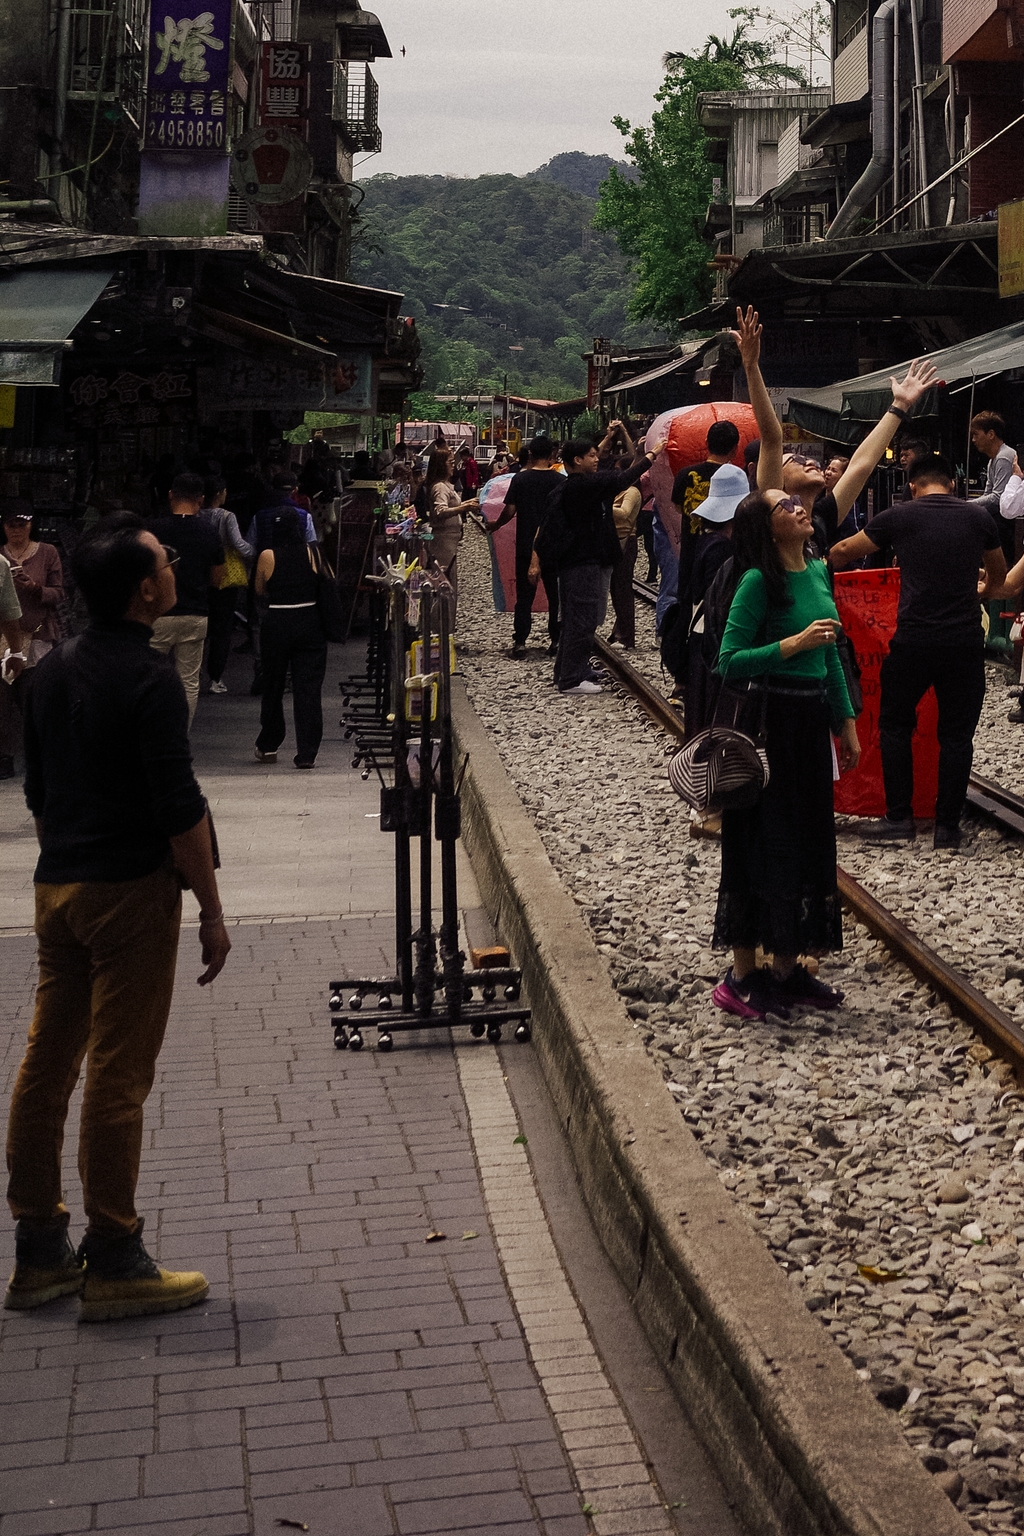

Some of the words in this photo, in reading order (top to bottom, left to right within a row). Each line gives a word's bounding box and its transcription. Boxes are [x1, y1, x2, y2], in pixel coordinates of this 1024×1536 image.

[265, 47, 302, 124] 協豐
[150, 89, 225, 116] 批發零售
[149, 119, 224, 147] 24958850
[69, 370, 193, 406] 你會紅
